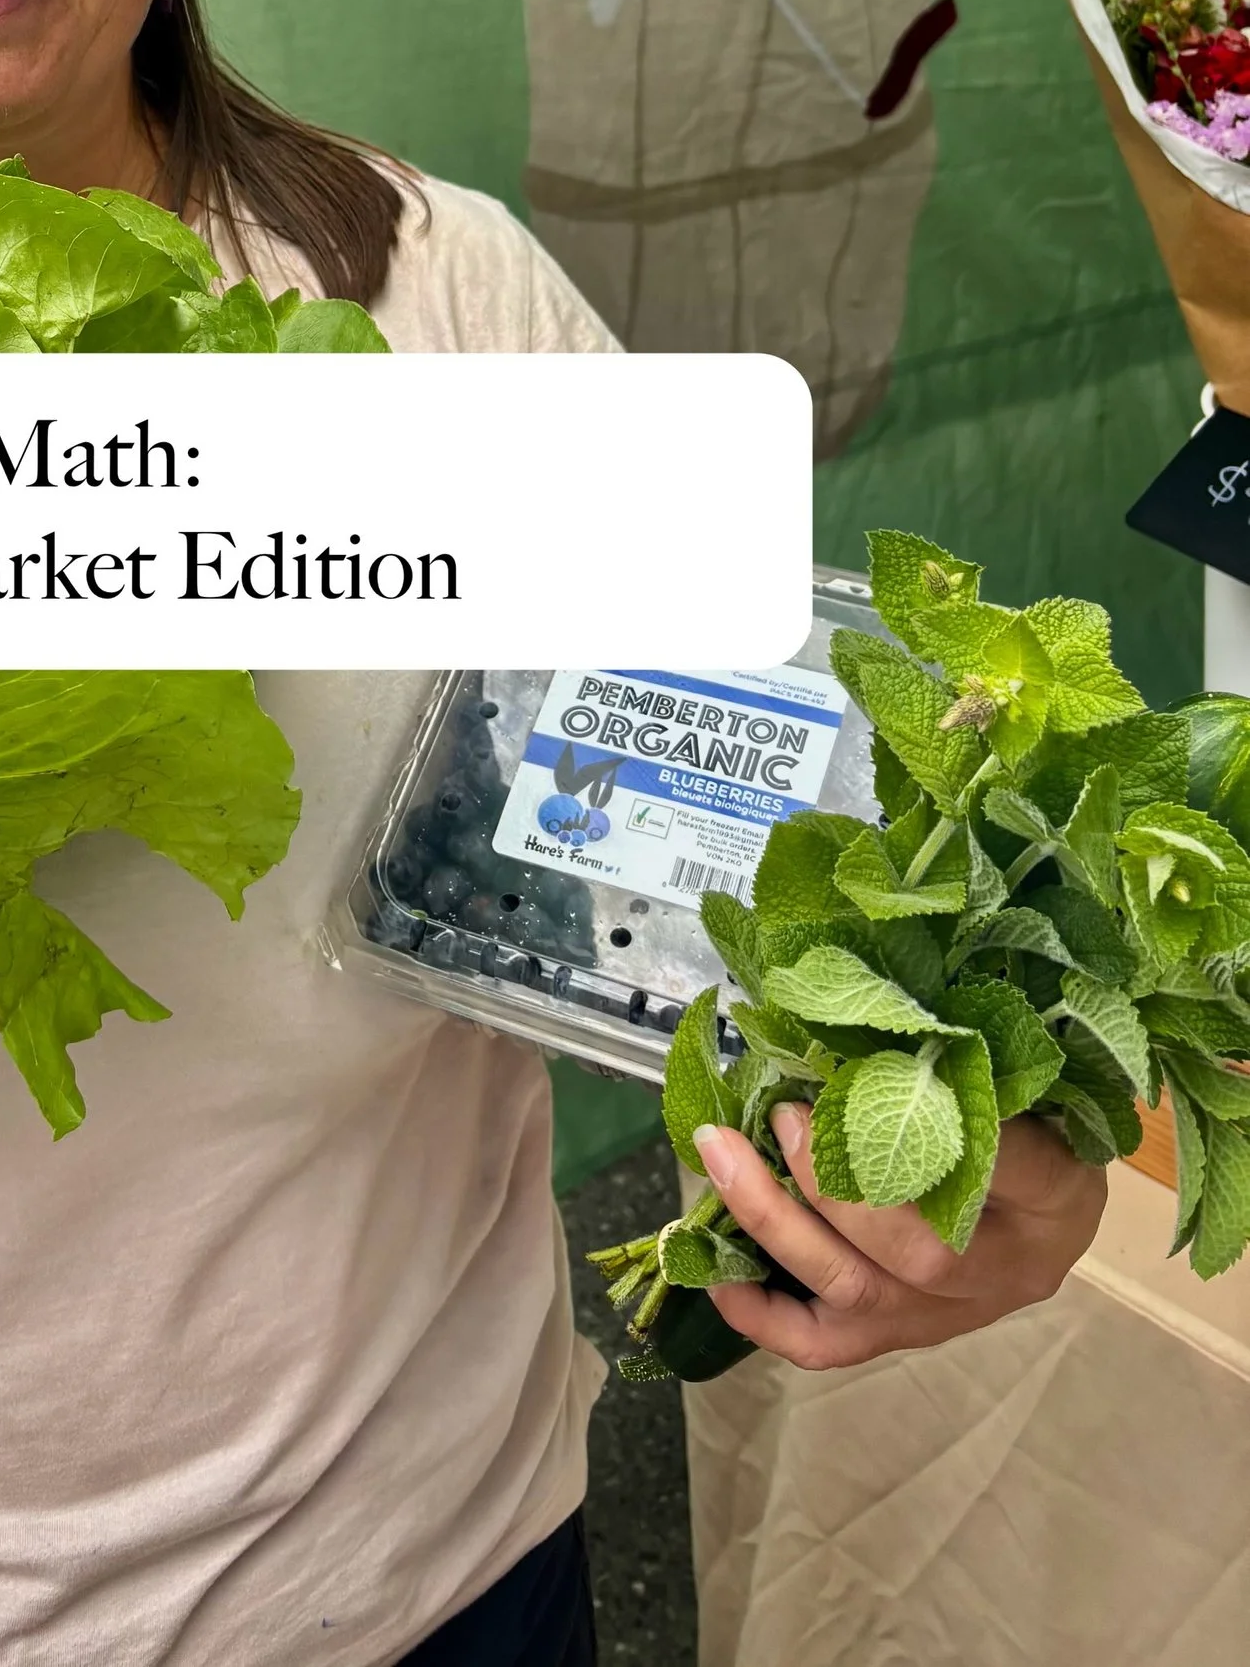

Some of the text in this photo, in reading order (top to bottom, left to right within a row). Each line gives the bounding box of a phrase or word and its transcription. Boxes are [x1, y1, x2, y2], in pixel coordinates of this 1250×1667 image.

[576, 676, 810, 754] PEMBERTON
[559, 705, 800, 791] ORGANIC
[658, 768, 784, 813] BLUEBERRIES
[671, 786, 713, 805] bleuets
[690, 814, 709, 825] your
[741, 827, 765, 839] Email
[697, 831, 709, 841] for
[710, 836, 728, 846] bulk
[524, 833, 603, 871] Hare's Farm
[743, 853, 757, 863] BC
